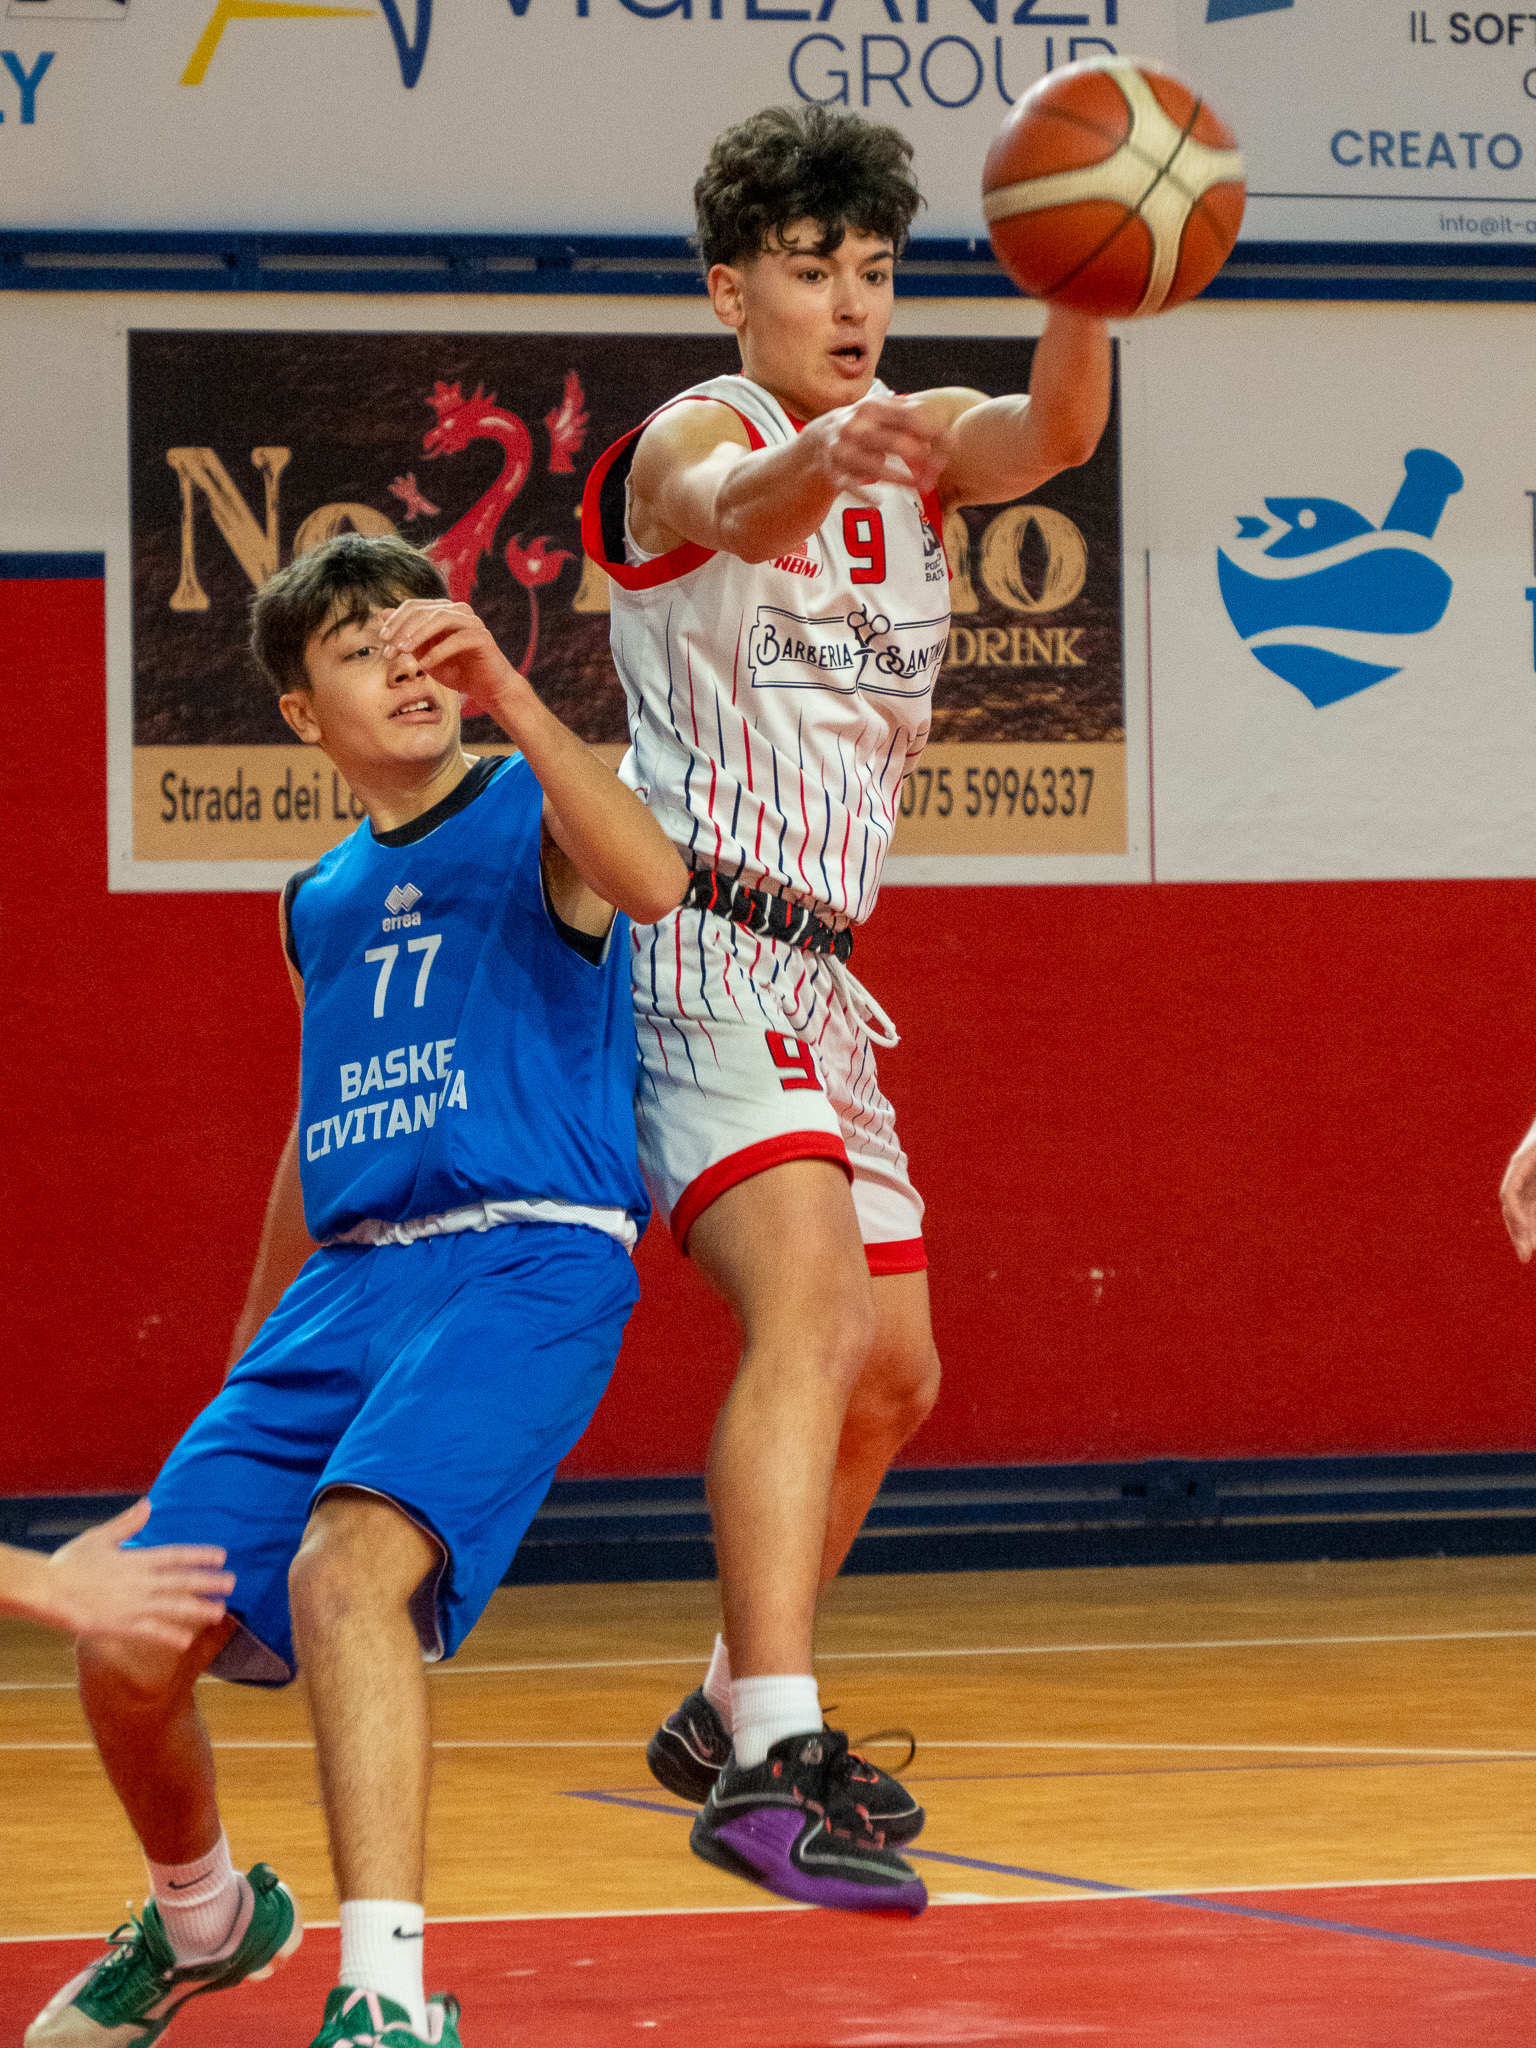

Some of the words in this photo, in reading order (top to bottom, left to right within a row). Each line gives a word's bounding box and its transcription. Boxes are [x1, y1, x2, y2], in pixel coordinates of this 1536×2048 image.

[1410, 10, 1437, 44] IL
[1330, 128, 1524, 171] CREATO
[773, 555, 819, 579] NBM
[842, 507, 887, 585] 9
[756, 623, 854, 669] BARBERIA
[947, 626, 1088, 667] DRINK
[161, 767, 262, 823] Strada
[273, 767, 321, 821] dei
[900, 766, 954, 818] 075
[965, 766, 1095, 818] 5996337
[364, 933, 443, 1019] 77
